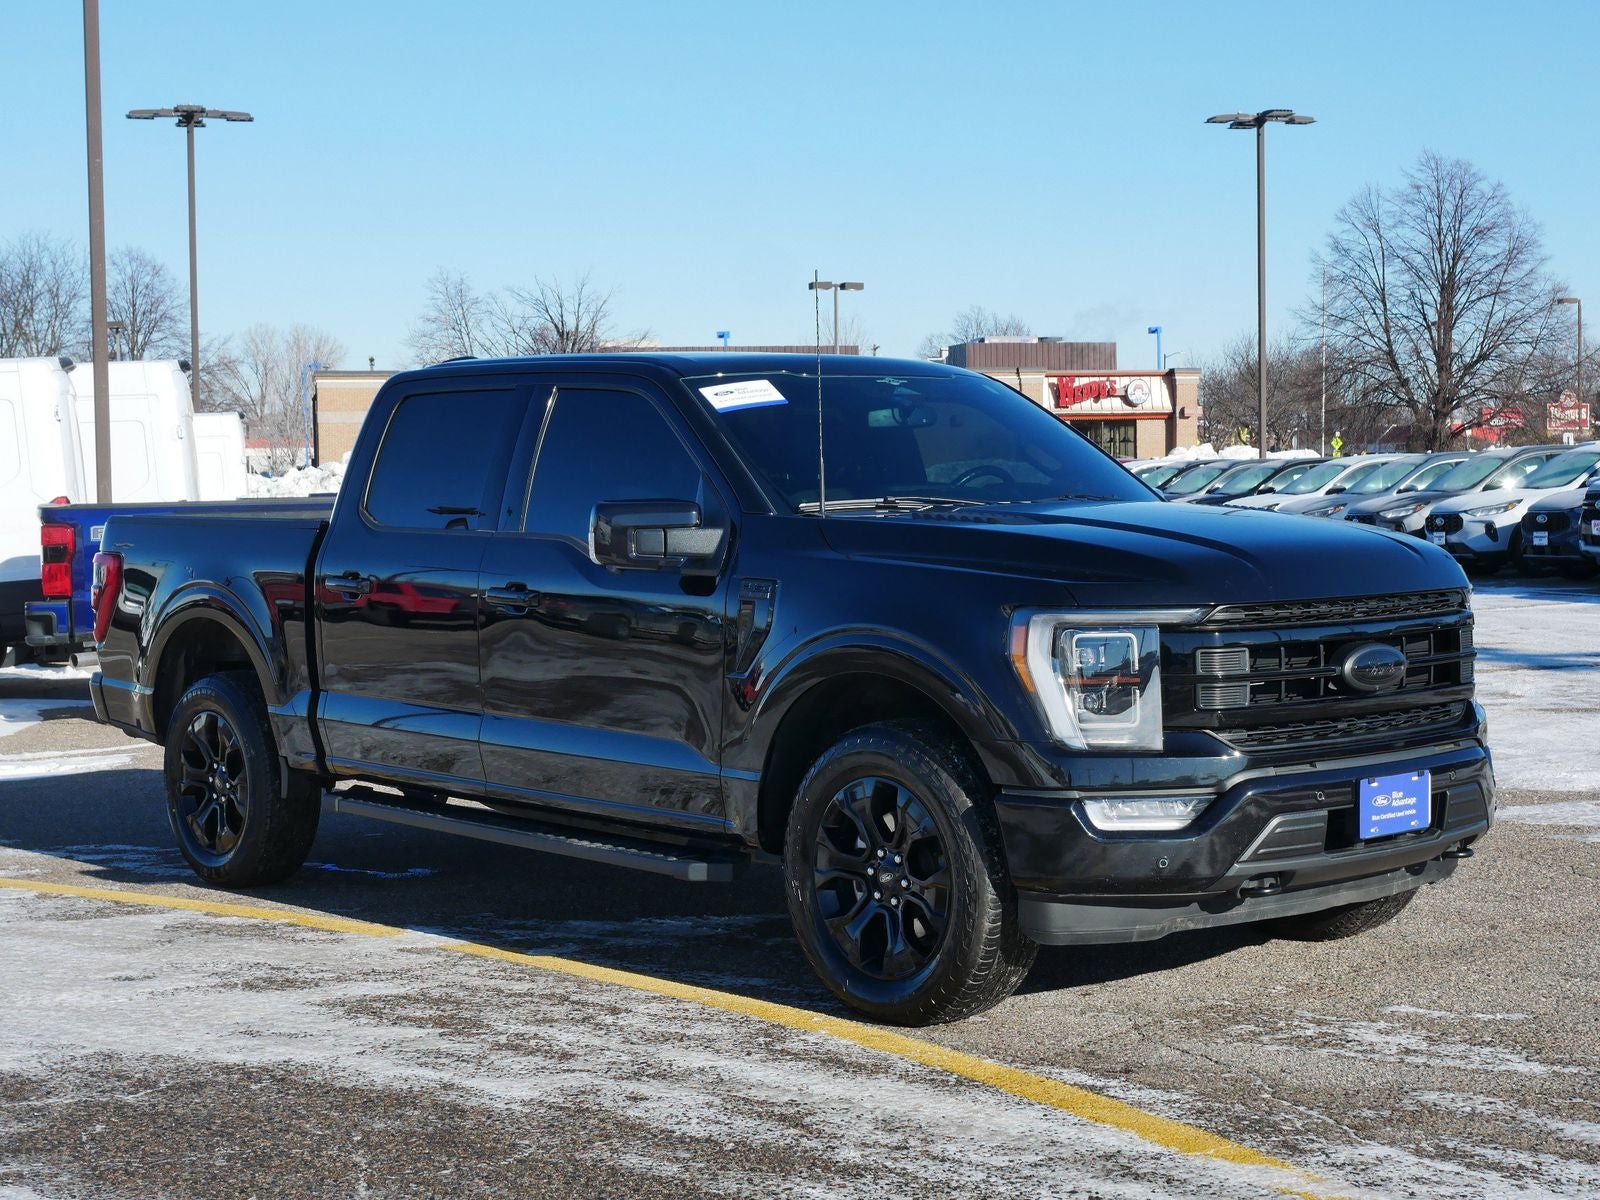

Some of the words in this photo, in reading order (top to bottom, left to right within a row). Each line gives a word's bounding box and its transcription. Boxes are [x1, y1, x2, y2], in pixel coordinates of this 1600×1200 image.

[1391, 790, 1404, 798] Blue
[1374, 795, 1390, 806] Ford
[1391, 797, 1417, 807] Advantage
